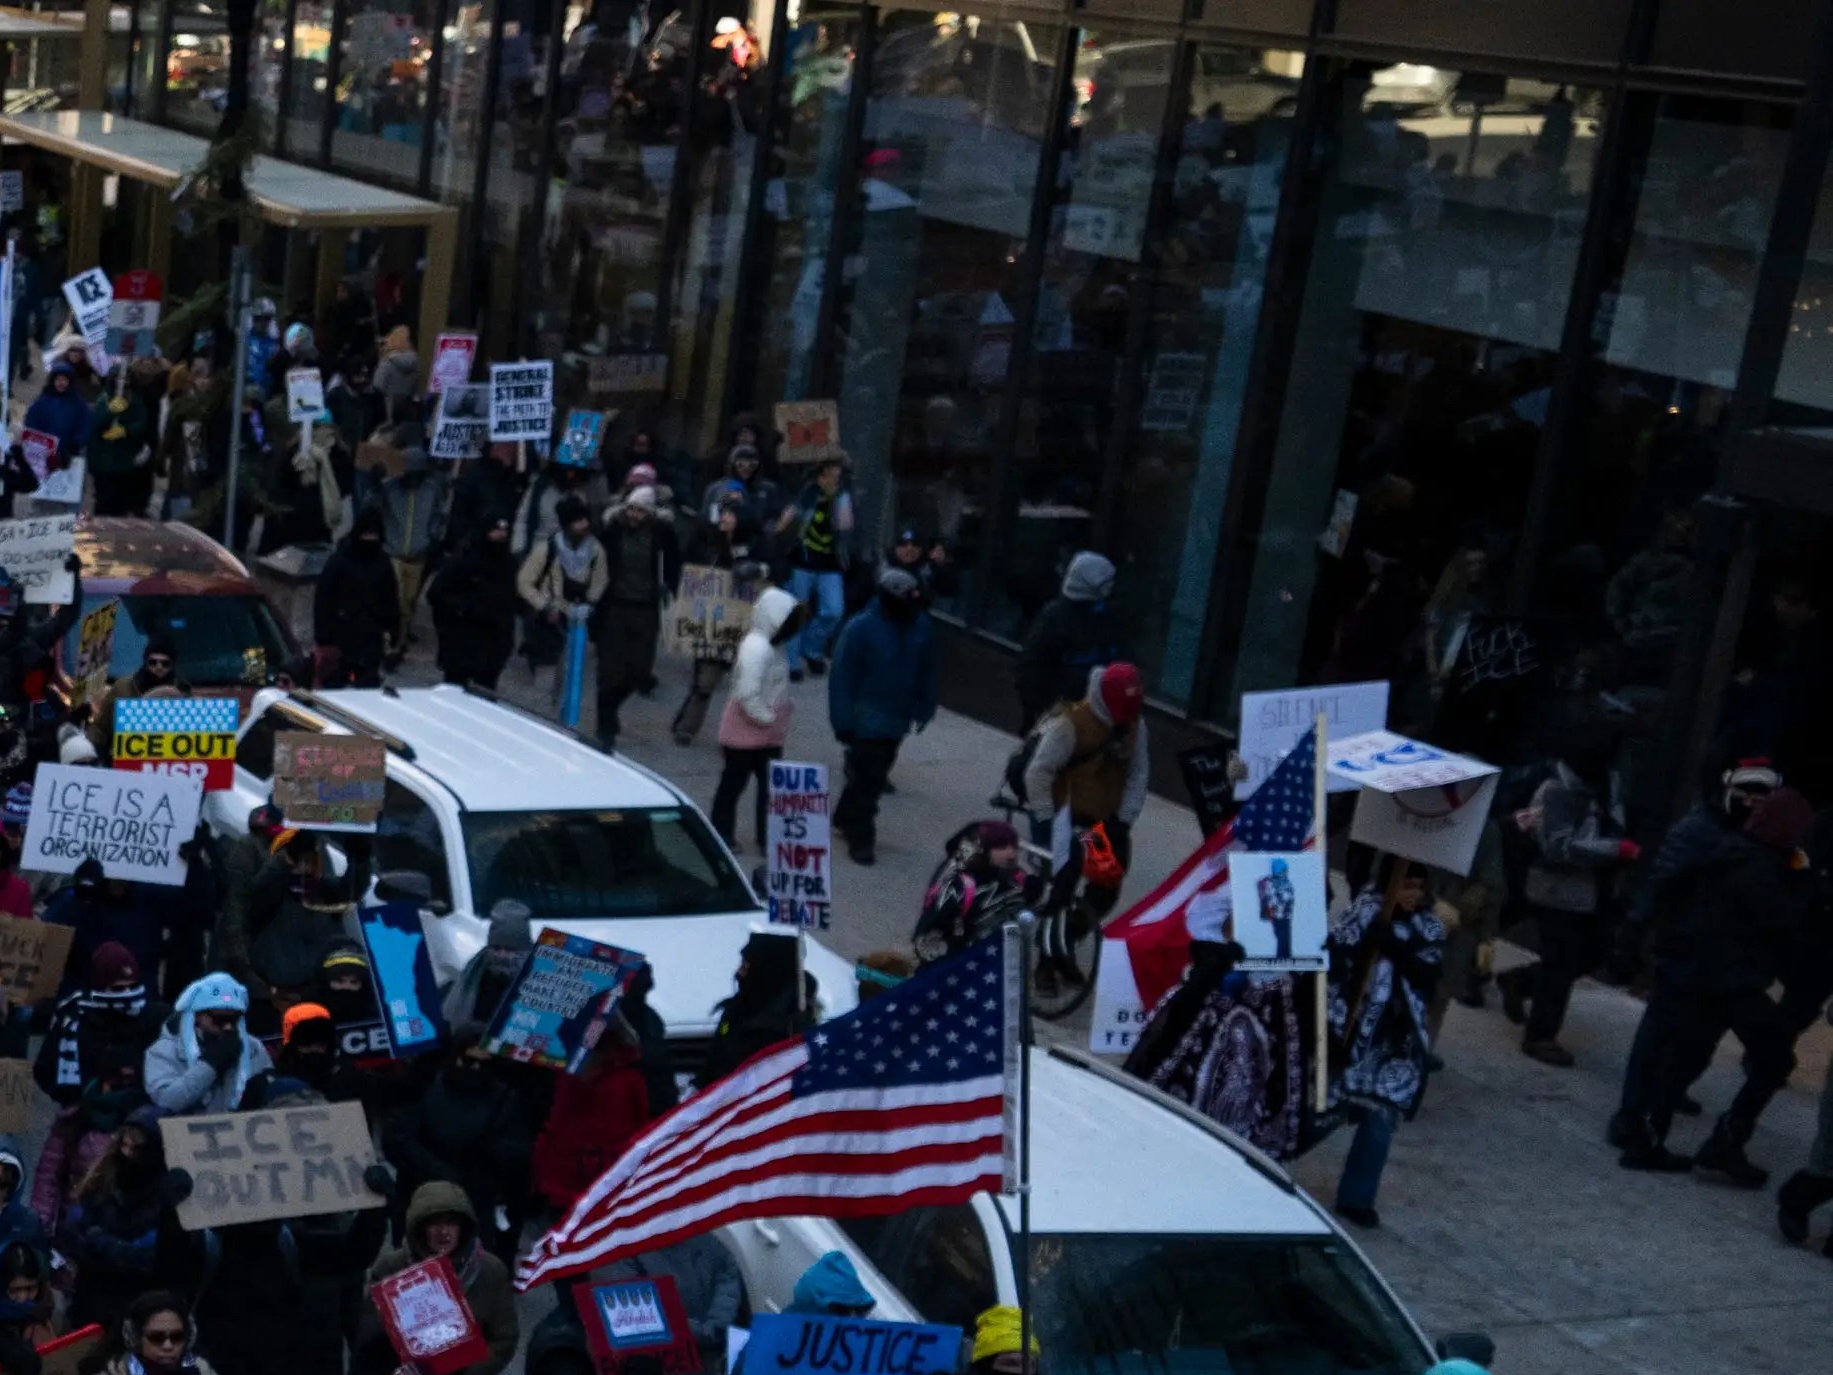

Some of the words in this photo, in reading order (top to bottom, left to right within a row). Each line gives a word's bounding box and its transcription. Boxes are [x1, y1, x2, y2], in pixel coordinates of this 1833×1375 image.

[495, 369, 549, 382] GENERAL
[494, 385, 545, 401] STRIKE
[493, 418, 547, 435] JUSTICE
[116, 734, 164, 757] ICE
[170, 734, 234, 757] OUT
[770, 767, 818, 790] OUR
[47, 780, 98, 816] ICE
[114, 787, 145, 821] IS
[149, 794, 174, 822] A
[46, 812, 174, 846] TERRORIST
[783, 819, 807, 840] IS
[39, 836, 170, 870] ORGANIZATION
[777, 845, 827, 872] NOT
[770, 873, 793, 894] UP
[795, 873, 827, 895] FOR
[769, 896, 830, 930] DEBATE
[556, 966, 583, 983] AND
[188, 1112, 333, 1168] ICE
[194, 1163, 291, 1213] OUT
